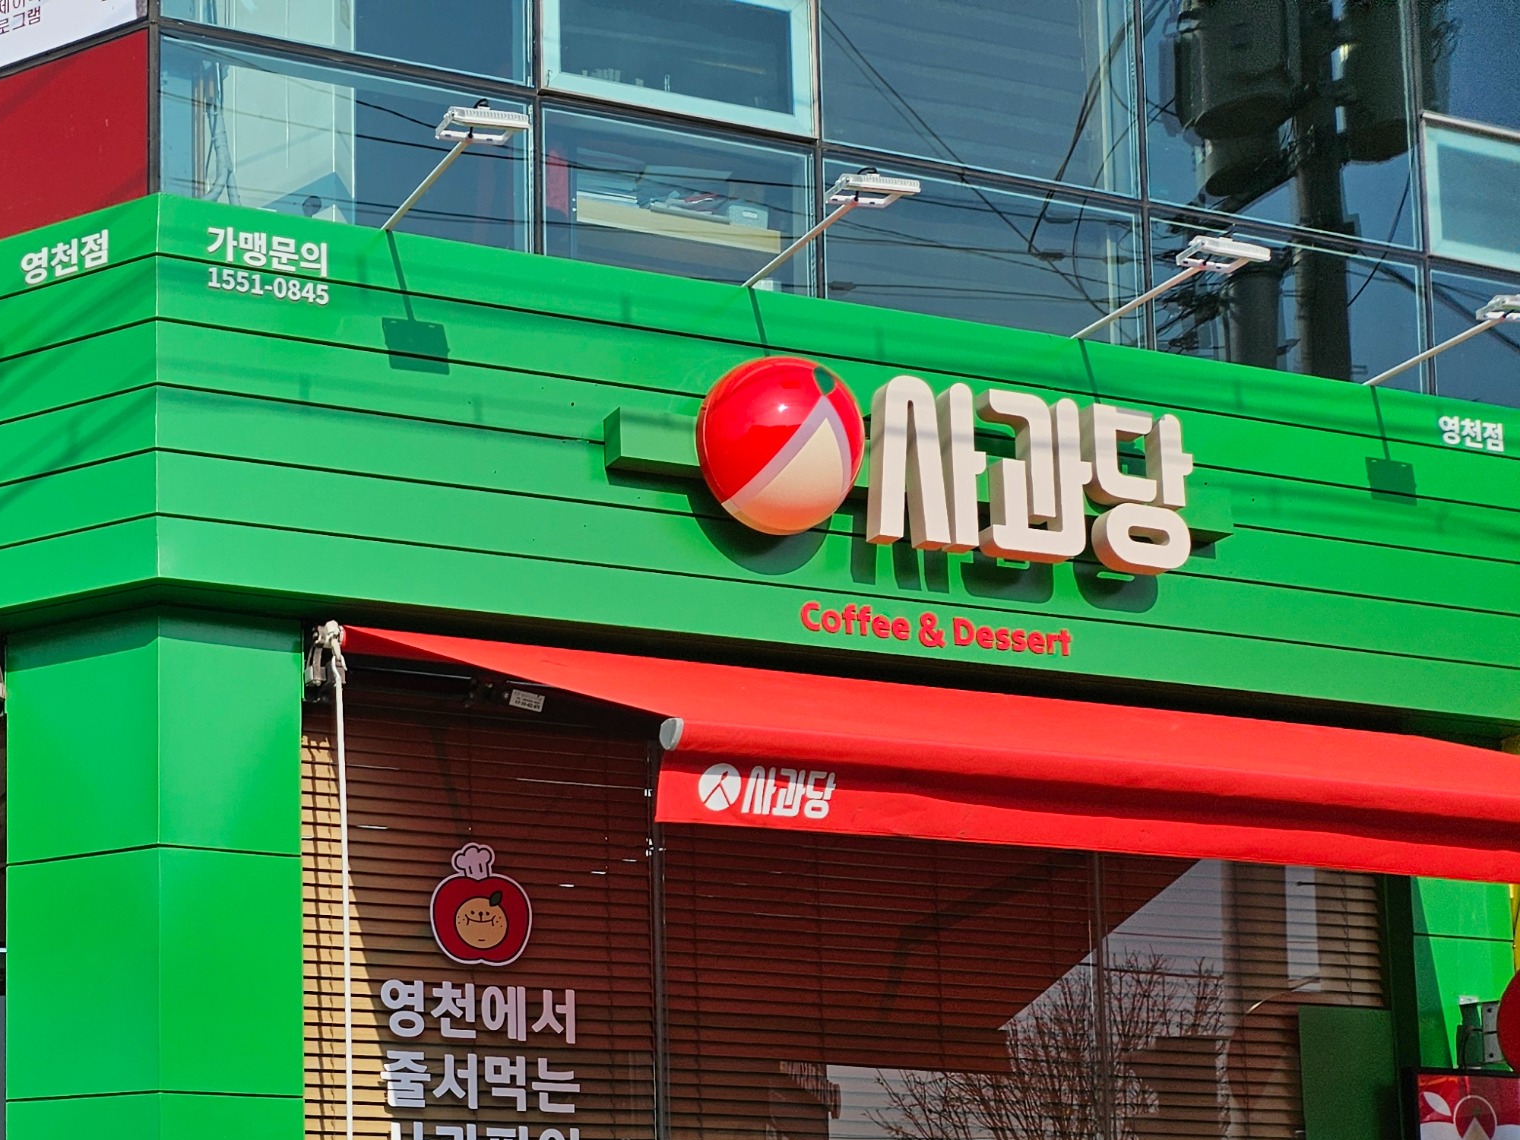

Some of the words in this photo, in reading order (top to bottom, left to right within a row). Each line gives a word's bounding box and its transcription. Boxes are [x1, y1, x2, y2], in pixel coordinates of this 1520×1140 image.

[19, 229, 110, 285] 영천점
[206, 226, 329, 278] 가맹문의
[207, 267, 330, 306] 1551-0845
[1438, 415, 1504, 452] 영천점
[866, 374, 1194, 576] 사과당
[800, 601, 911, 642] Coffee
[919, 611, 946, 649] &
[953, 616, 1073, 657] Dessert
[741, 765, 837, 820] 사과당
[379, 978, 577, 1045] 영천에서
[378, 1049, 580, 1114] 줄서먹는
